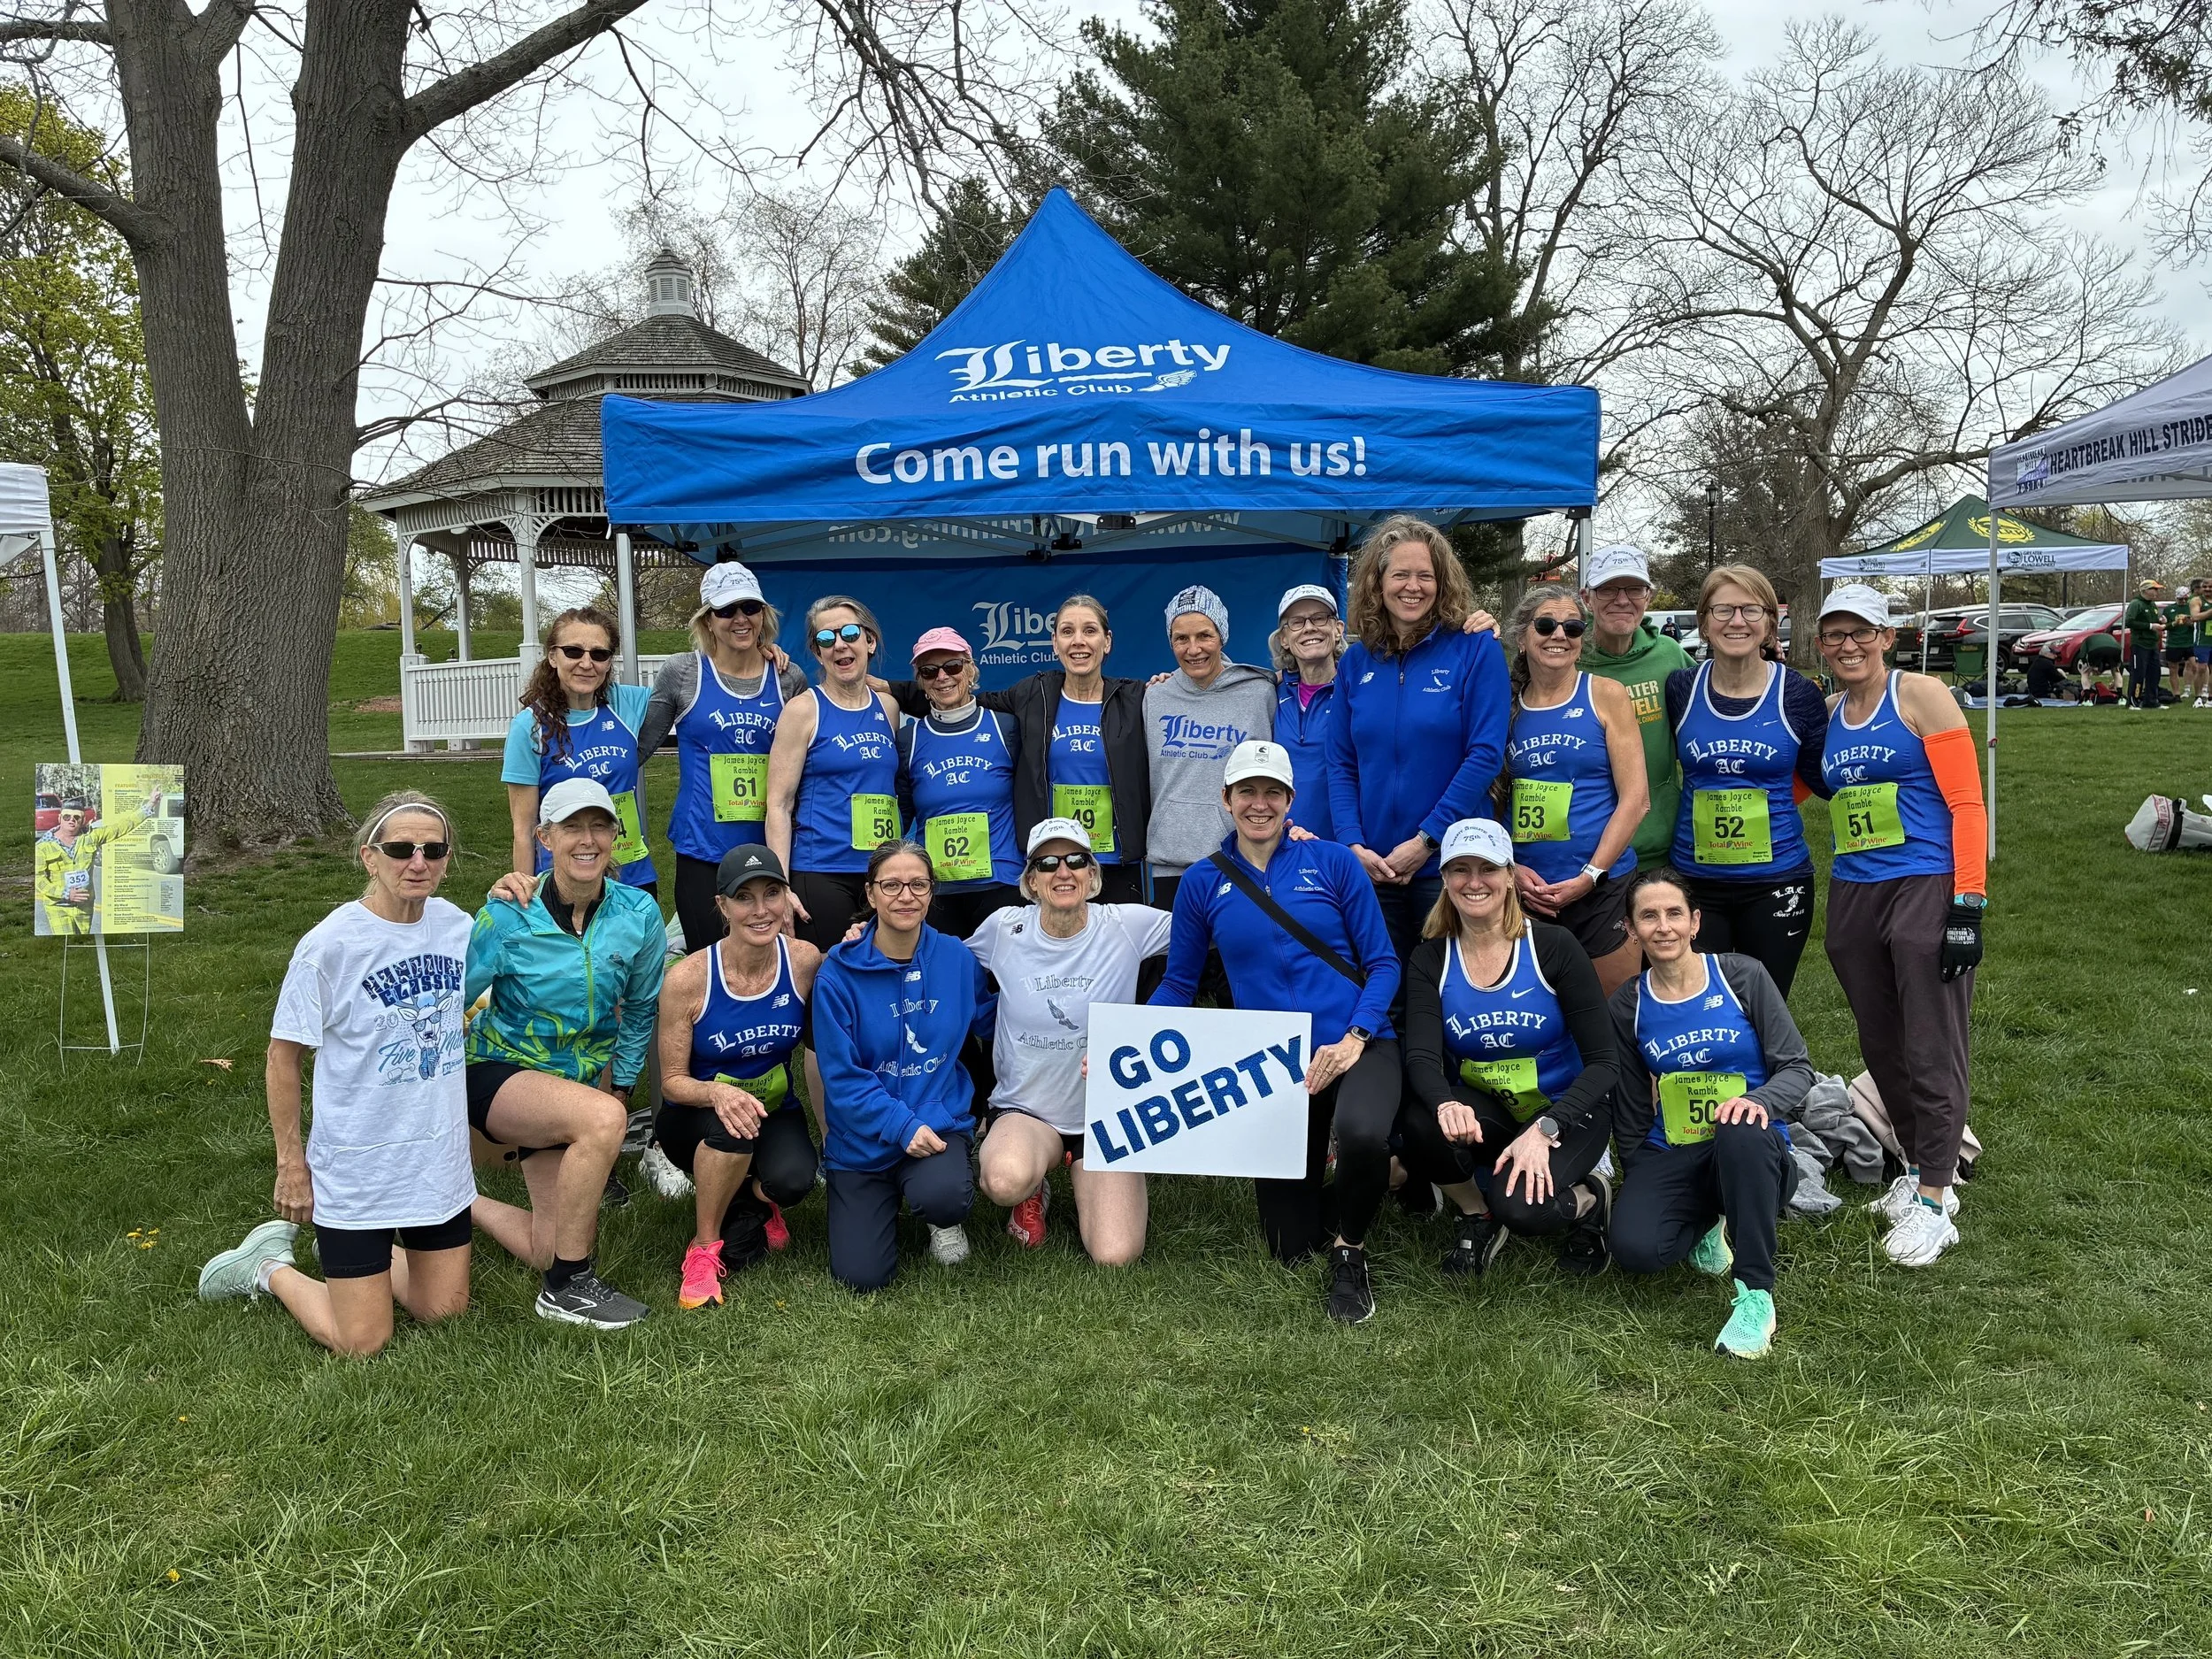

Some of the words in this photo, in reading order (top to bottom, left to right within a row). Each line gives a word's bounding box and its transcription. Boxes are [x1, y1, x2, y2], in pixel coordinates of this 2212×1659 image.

[934, 339, 1231, 392] Liberty
[949, 388, 1058, 403] Athletic
[1067, 384, 1133, 396] Club
[856, 442, 1020, 485] Come
[1036, 442, 1132, 479] run
[1149, 428, 1277, 476] with
[1291, 435, 1367, 477] us!
[2050, 434, 2125, 475] HEARTBREAK
[2129, 427, 2159, 457] HILL
[972, 601, 1057, 652] Libe
[979, 652, 1027, 665] Athletic
[1031, 651, 1059, 663] Club
[1625, 680, 1660, 699] ATER
[709, 709, 778, 735] LIBERTY
[1158, 714, 1248, 749] Liberty
[734, 727, 757, 745] AC
[832, 732, 894, 752] LIBERTY
[1052, 723, 1101, 742] LIBER
[859, 746, 882, 761] AC
[1069, 739, 1096, 752] AC
[1160, 749, 1187, 757] Athletic
[1188, 749, 1209, 759] Club
[1506, 733, 1587, 761] LIBERTY
[1686, 737, 1778, 764] LIBERTY
[559, 745, 628, 773] LIBERTY
[724, 756, 745, 764] James
[747, 756, 766, 766] Joyce
[923, 756, 993, 780] LIBERTY
[1528, 750, 1557, 768] AC
[1715, 758, 1746, 774] AC
[1821, 745, 1897, 777] LIBERTY
[588, 761, 613, 779] AC
[945, 771, 971, 787] AC
[1840, 764, 1869, 786] AC
[733, 777, 757, 797] 61
[1064, 787, 1082, 795] James
[1084, 787, 1102, 797] Joyce
[1535, 782, 1558, 793] Joyce
[1838, 790, 1857, 802] James
[1860, 787, 1882, 797] Joyce
[864, 795, 885, 805] James
[1071, 797, 1094, 806] Ramble
[1519, 793, 1546, 803] Ramble
[1706, 792, 1727, 802] James
[1730, 792, 1753, 803] Joyce
[1847, 798, 1872, 810] Ramble
[1517, 805, 1545, 829] 53
[1715, 803, 1743, 813] Ramble
[935, 818, 955, 827] James
[956, 815, 976, 826] Joyce
[1072, 809, 1095, 829] 49
[1715, 816, 1746, 839] 52
[1847, 810, 1875, 838] 51
[873, 818, 895, 840] 58
[943, 826, 968, 835] Ramble
[943, 836, 970, 858] 62
[1846, 840, 1860, 849] Total
[69, 874, 87, 884] 352
[379, 974, 461, 1008] CLASSIC
[1034, 974, 1094, 992] Liberty
[373, 1011, 399, 1032] 20
[1447, 1010, 1547, 1041] LIBERTY
[708, 1024, 802, 1054] LIBERTY
[1018, 1032, 1074, 1051] Athletic
[1479, 1032, 1517, 1049] AC
[1645, 1027, 1741, 1063] LIBERTY
[378, 1039, 416, 1073] Five
[741, 1041, 775, 1058] AC
[1109, 1028, 1191, 1090] GO
[1677, 1048, 1713, 1068] AC
[1471, 1063, 1494, 1073] James
[1497, 1063, 1521, 1073] Joyce
[757, 1073, 774, 1087] Joyce
[1481, 1075, 1511, 1086] Ramble
[1675, 1075, 1701, 1085] James
[1704, 1073, 1729, 1084] Joyce
[1090, 1034, 1306, 1164] LIBERTY
[1687, 1085, 1718, 1096] Ramble
[1689, 1099, 1718, 1125] 50
[1682, 1126, 1700, 1135] Total
